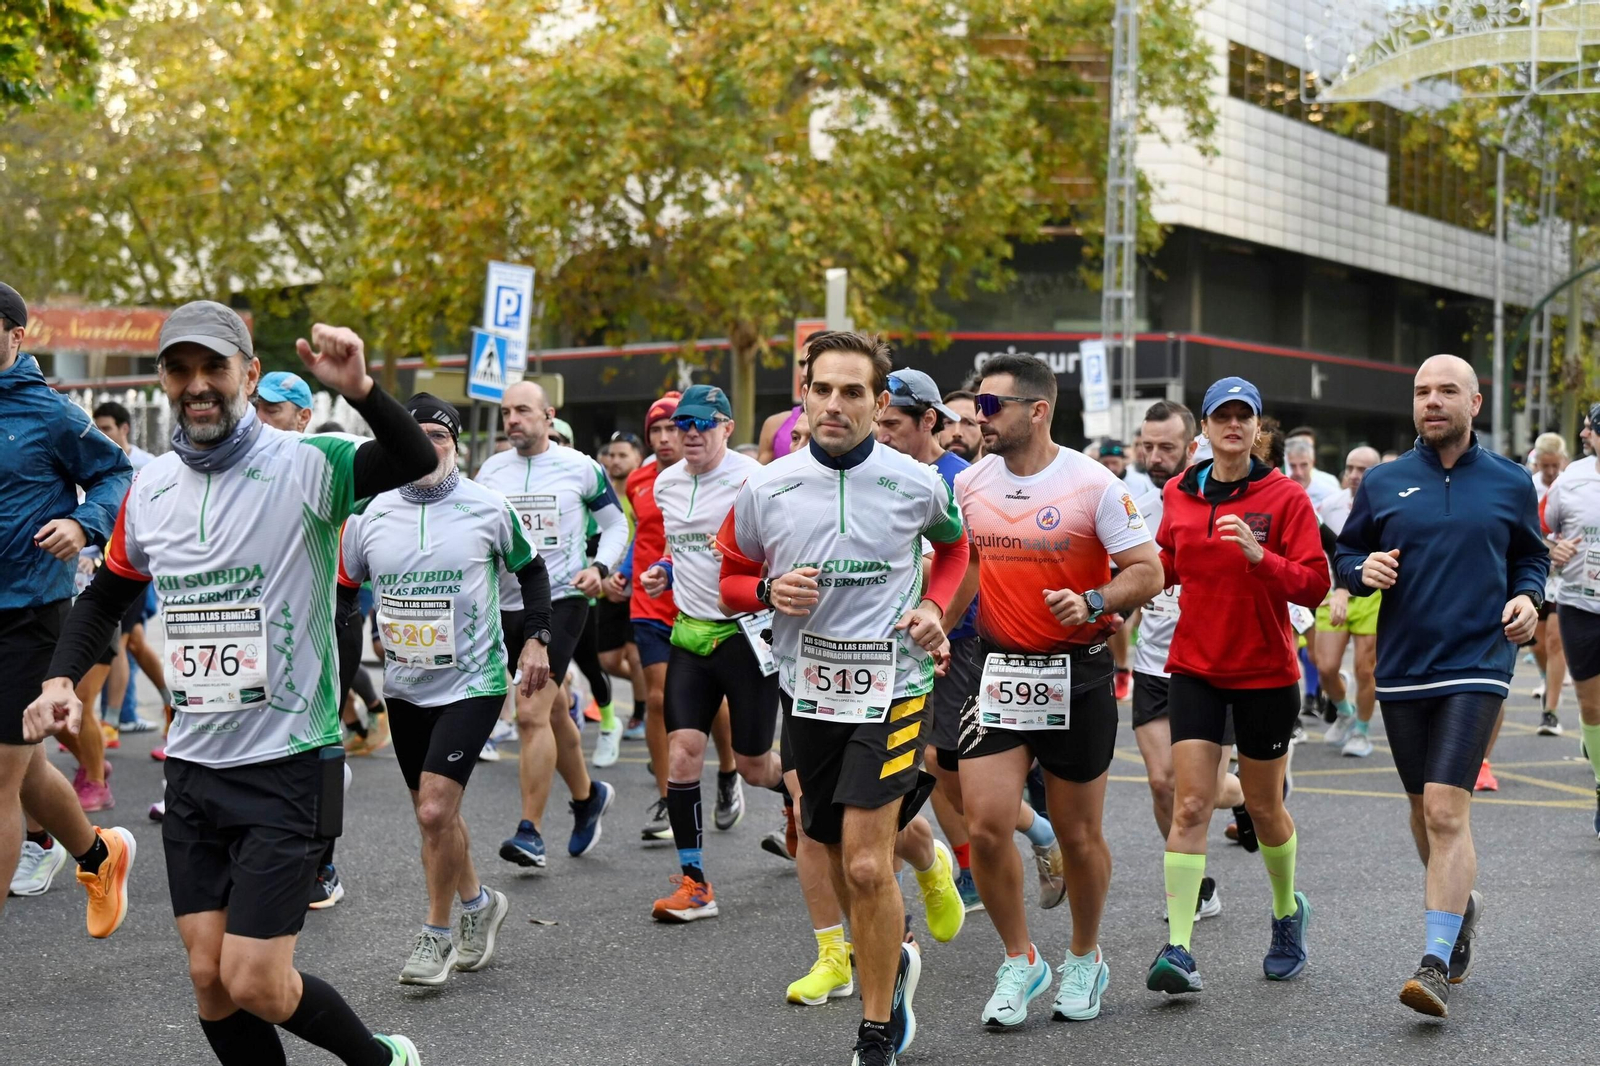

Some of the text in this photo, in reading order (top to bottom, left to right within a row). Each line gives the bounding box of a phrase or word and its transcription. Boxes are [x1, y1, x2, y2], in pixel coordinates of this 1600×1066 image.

[68, 318, 161, 342] Navidad
[877, 476, 899, 491] SIG
[452, 502, 471, 513] SIG
[520, 513, 545, 531] 81
[678, 532, 708, 544] SUBI
[822, 559, 892, 574] SUBIDA
[1005, 555, 1033, 563] persona
[156, 563, 266, 591] XII SUBIDA
[378, 569, 463, 585] XII SUBIDA
[817, 574, 888, 588] AS ERMITAS
[198, 585, 263, 604] ERMITAS
[411, 585, 461, 596] ERMITAS
[175, 612, 200, 622] SUBIDA
[200, 612, 206, 621] A
[206, 611, 220, 621] LAS
[221, 609, 256, 620] ERMITAS
[216, 624, 225, 633] DE
[388, 622, 436, 647] 520
[813, 638, 837, 650] SUBIDA
[838, 642, 844, 650] A
[844, 642, 857, 651] LAS
[858, 642, 889, 651] ERMITAS
[182, 643, 240, 677] 576
[803, 645, 815, 655] POR
[815, 648, 822, 656] LA
[822, 650, 852, 660] DONACIÓN
[862, 652, 891, 661] ORGANOS
[816, 665, 872, 695] 519
[998, 680, 1050, 706] 598
